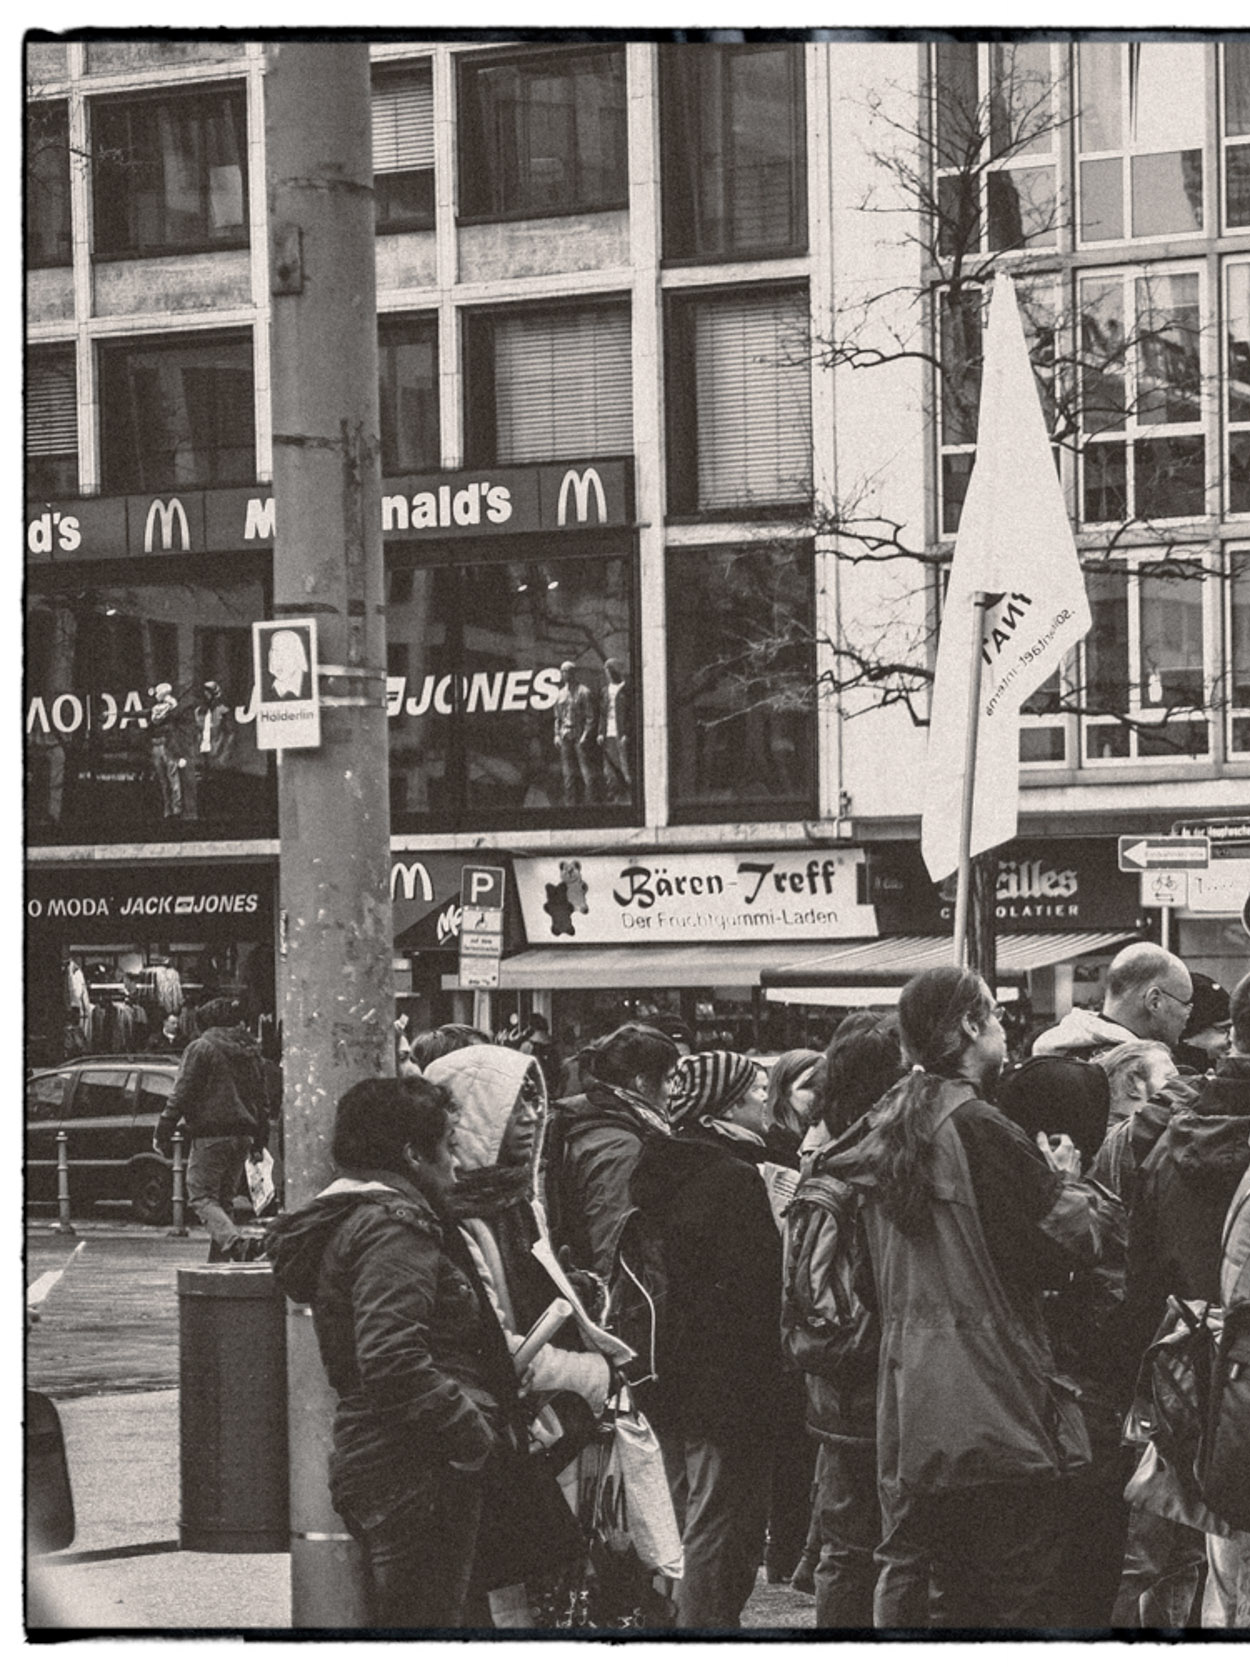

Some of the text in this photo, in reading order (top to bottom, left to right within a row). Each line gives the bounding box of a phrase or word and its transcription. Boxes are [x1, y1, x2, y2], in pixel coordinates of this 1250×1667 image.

[405, 668, 562, 716] JONES
[470, 871, 494, 903] P
[613, 860, 836, 909] Bären-Treff
[47, 897, 109, 916] MODA
[120, 895, 174, 915] JACK
[193, 894, 258, 913] JONES
[621, 908, 839, 931] Der Fruchtgummi-Laden
